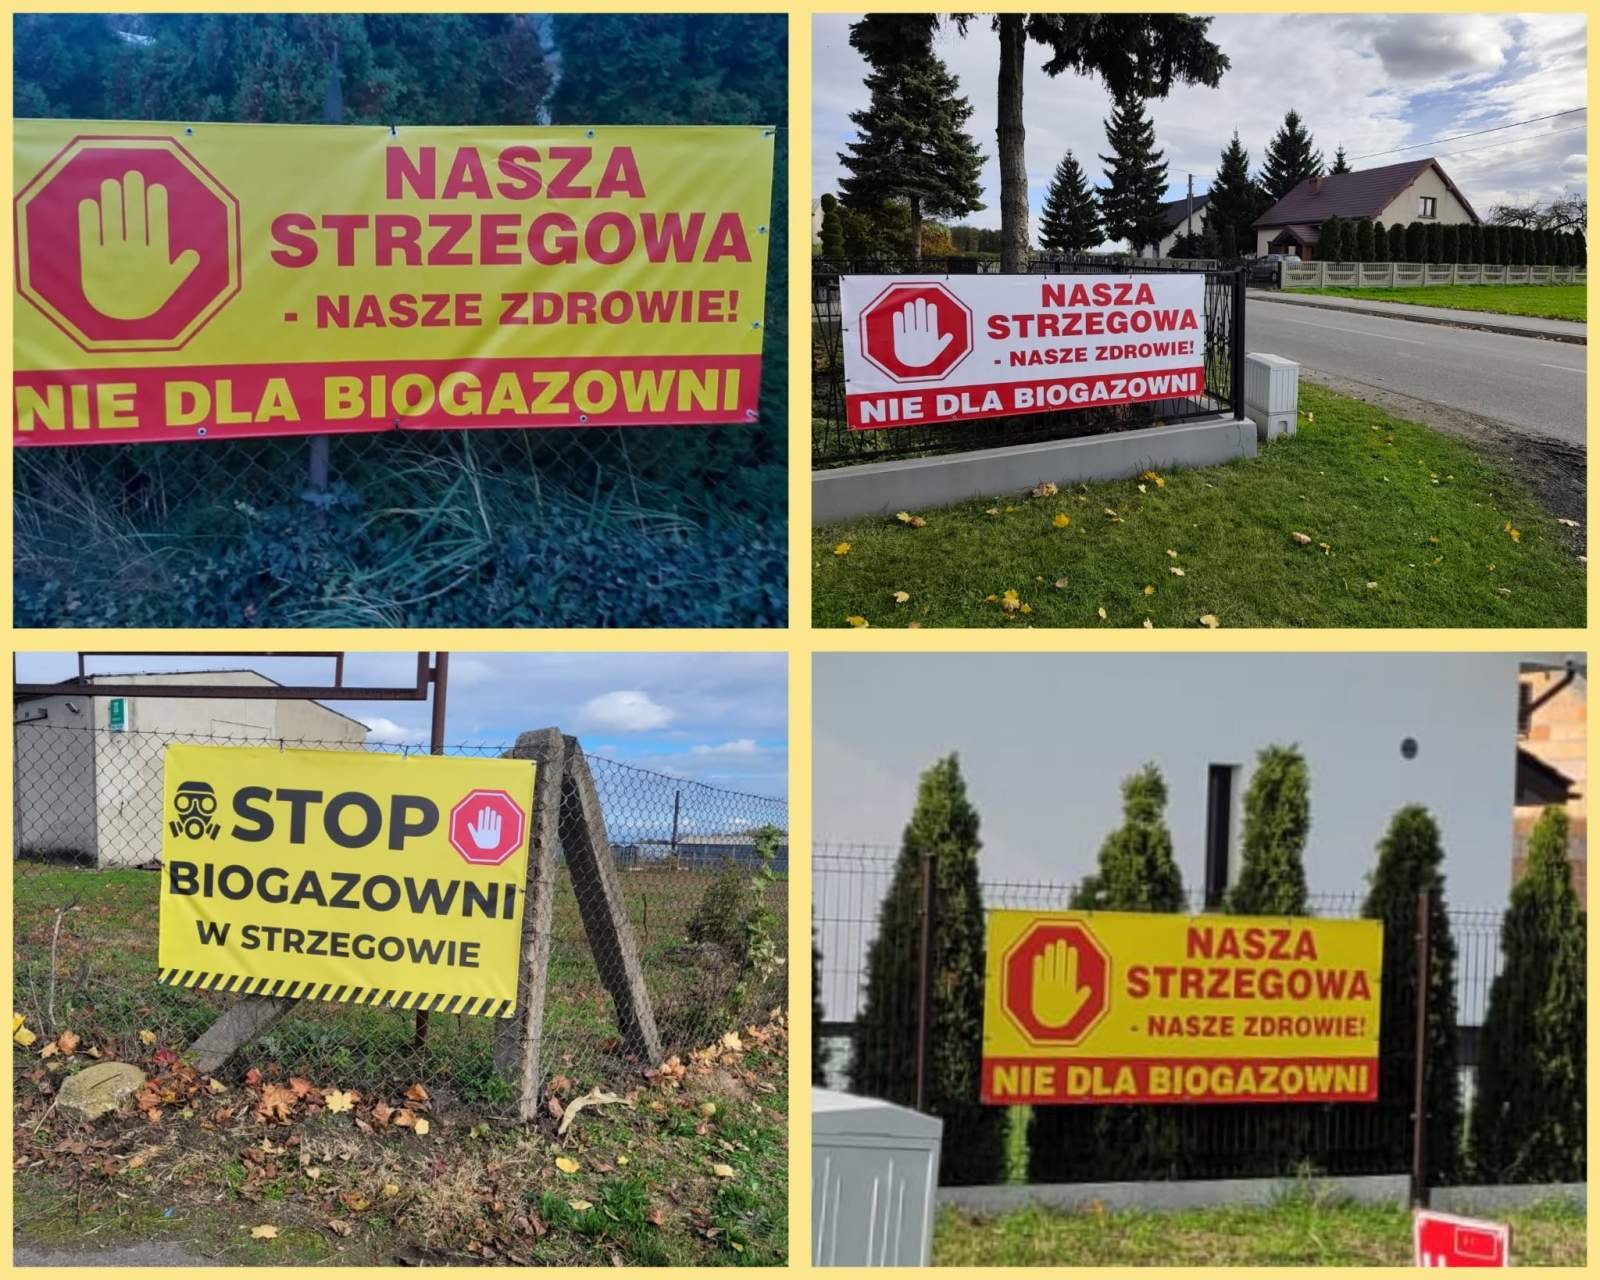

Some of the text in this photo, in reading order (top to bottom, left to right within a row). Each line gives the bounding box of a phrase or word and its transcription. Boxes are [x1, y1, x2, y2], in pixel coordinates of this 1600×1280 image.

[385, 145, 646, 200] NASZA
[270, 211, 752, 269] STRZEGOWA
[316, 292, 483, 330] NASZE
[499, 290, 740, 326] ZDROWIE!
[1041, 282, 1155, 308] NASZA
[986, 309, 1198, 340] STRZEGOWA
[1010, 346, 1088, 367] NASZE
[1095, 340, 1194, 361] ZDROWIE!
[15, 368, 742, 431] NIE DLA BIOGAZOWNI
[860, 373, 1197, 424] NIE DLA BIOGAZOWNI
[231, 785, 440, 851] STOP
[169, 860, 517, 920] BIOGAZOWNI
[196, 919, 481, 968] W STRZEGOWIE
[1186, 927, 1318, 961] NASZA
[1126, 966, 1372, 1000] STRZEGOWA
[1147, 1015, 1235, 1037] NASZE
[1243, 1015, 1366, 1037] ZDROWIE!
[992, 1064, 1368, 1096] NIE DLA BIOGAZOWNI
